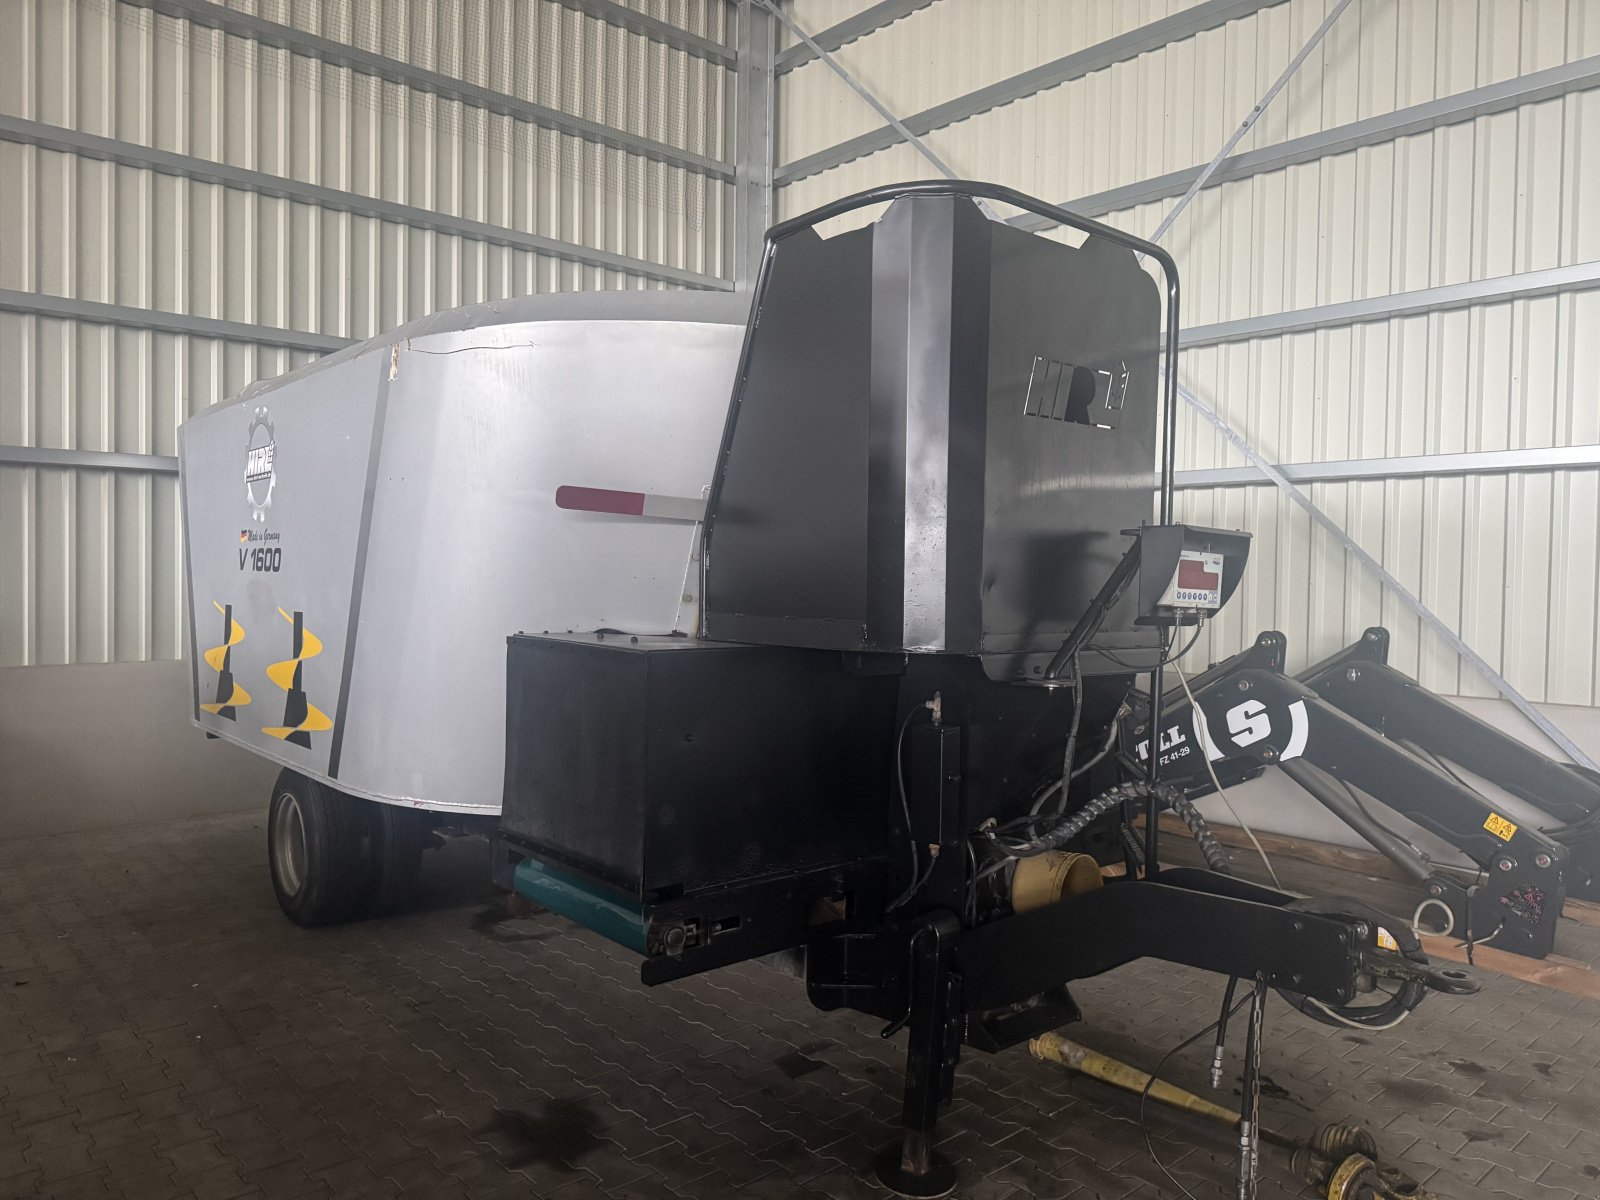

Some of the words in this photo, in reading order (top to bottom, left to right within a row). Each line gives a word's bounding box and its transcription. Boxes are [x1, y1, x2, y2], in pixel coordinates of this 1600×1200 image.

[239, 548, 248, 571] V
[251, 547, 282, 572] 1600
[1159, 755, 1170, 766] FZ
[1170, 746, 1190, 761] 41-29
